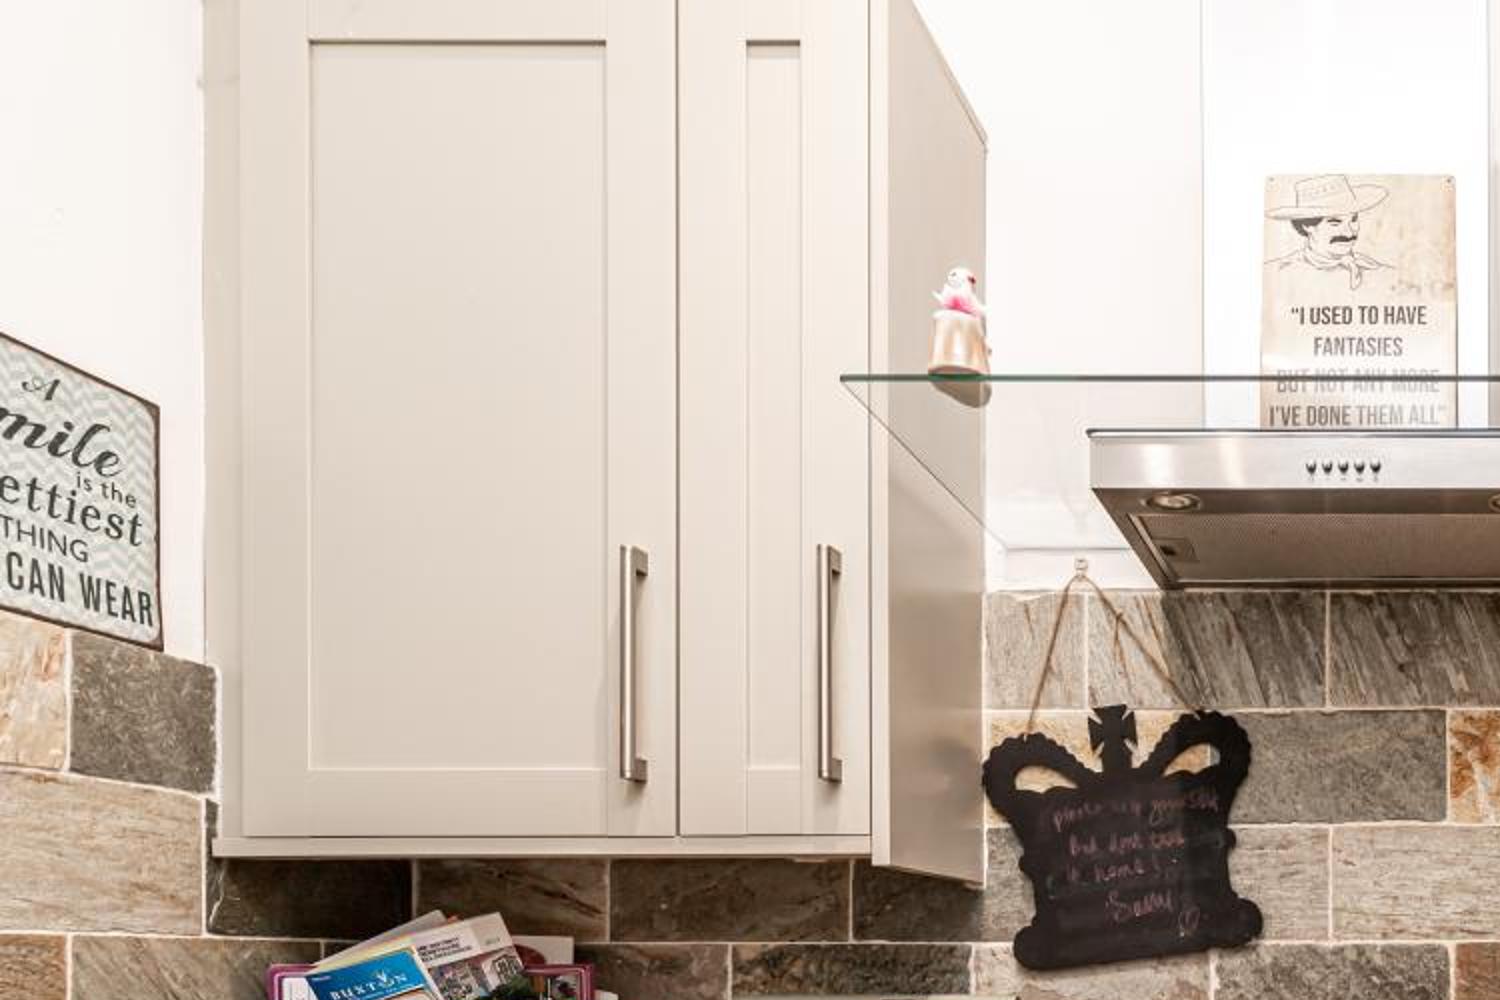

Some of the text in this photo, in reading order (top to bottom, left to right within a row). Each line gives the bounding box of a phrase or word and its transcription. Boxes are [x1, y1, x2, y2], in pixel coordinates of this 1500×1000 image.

[1309, 305, 1353, 326] USED
[1358, 305, 1379, 326] TO
[1383, 305, 1428, 326] HAVE
[1313, 336, 1403, 357] FANTASIES
[1276, 369, 1440, 394] BUT NOT ANY MORE
[1269, 405, 1301, 427] I'VE
[1306, 405, 1351, 427] DONE
[1357, 405, 1403, 427] THEM
[76, 471, 137, 509] is the
[0, 514, 90, 564] THING
[6, 551, 154, 628] CAN WEAR
